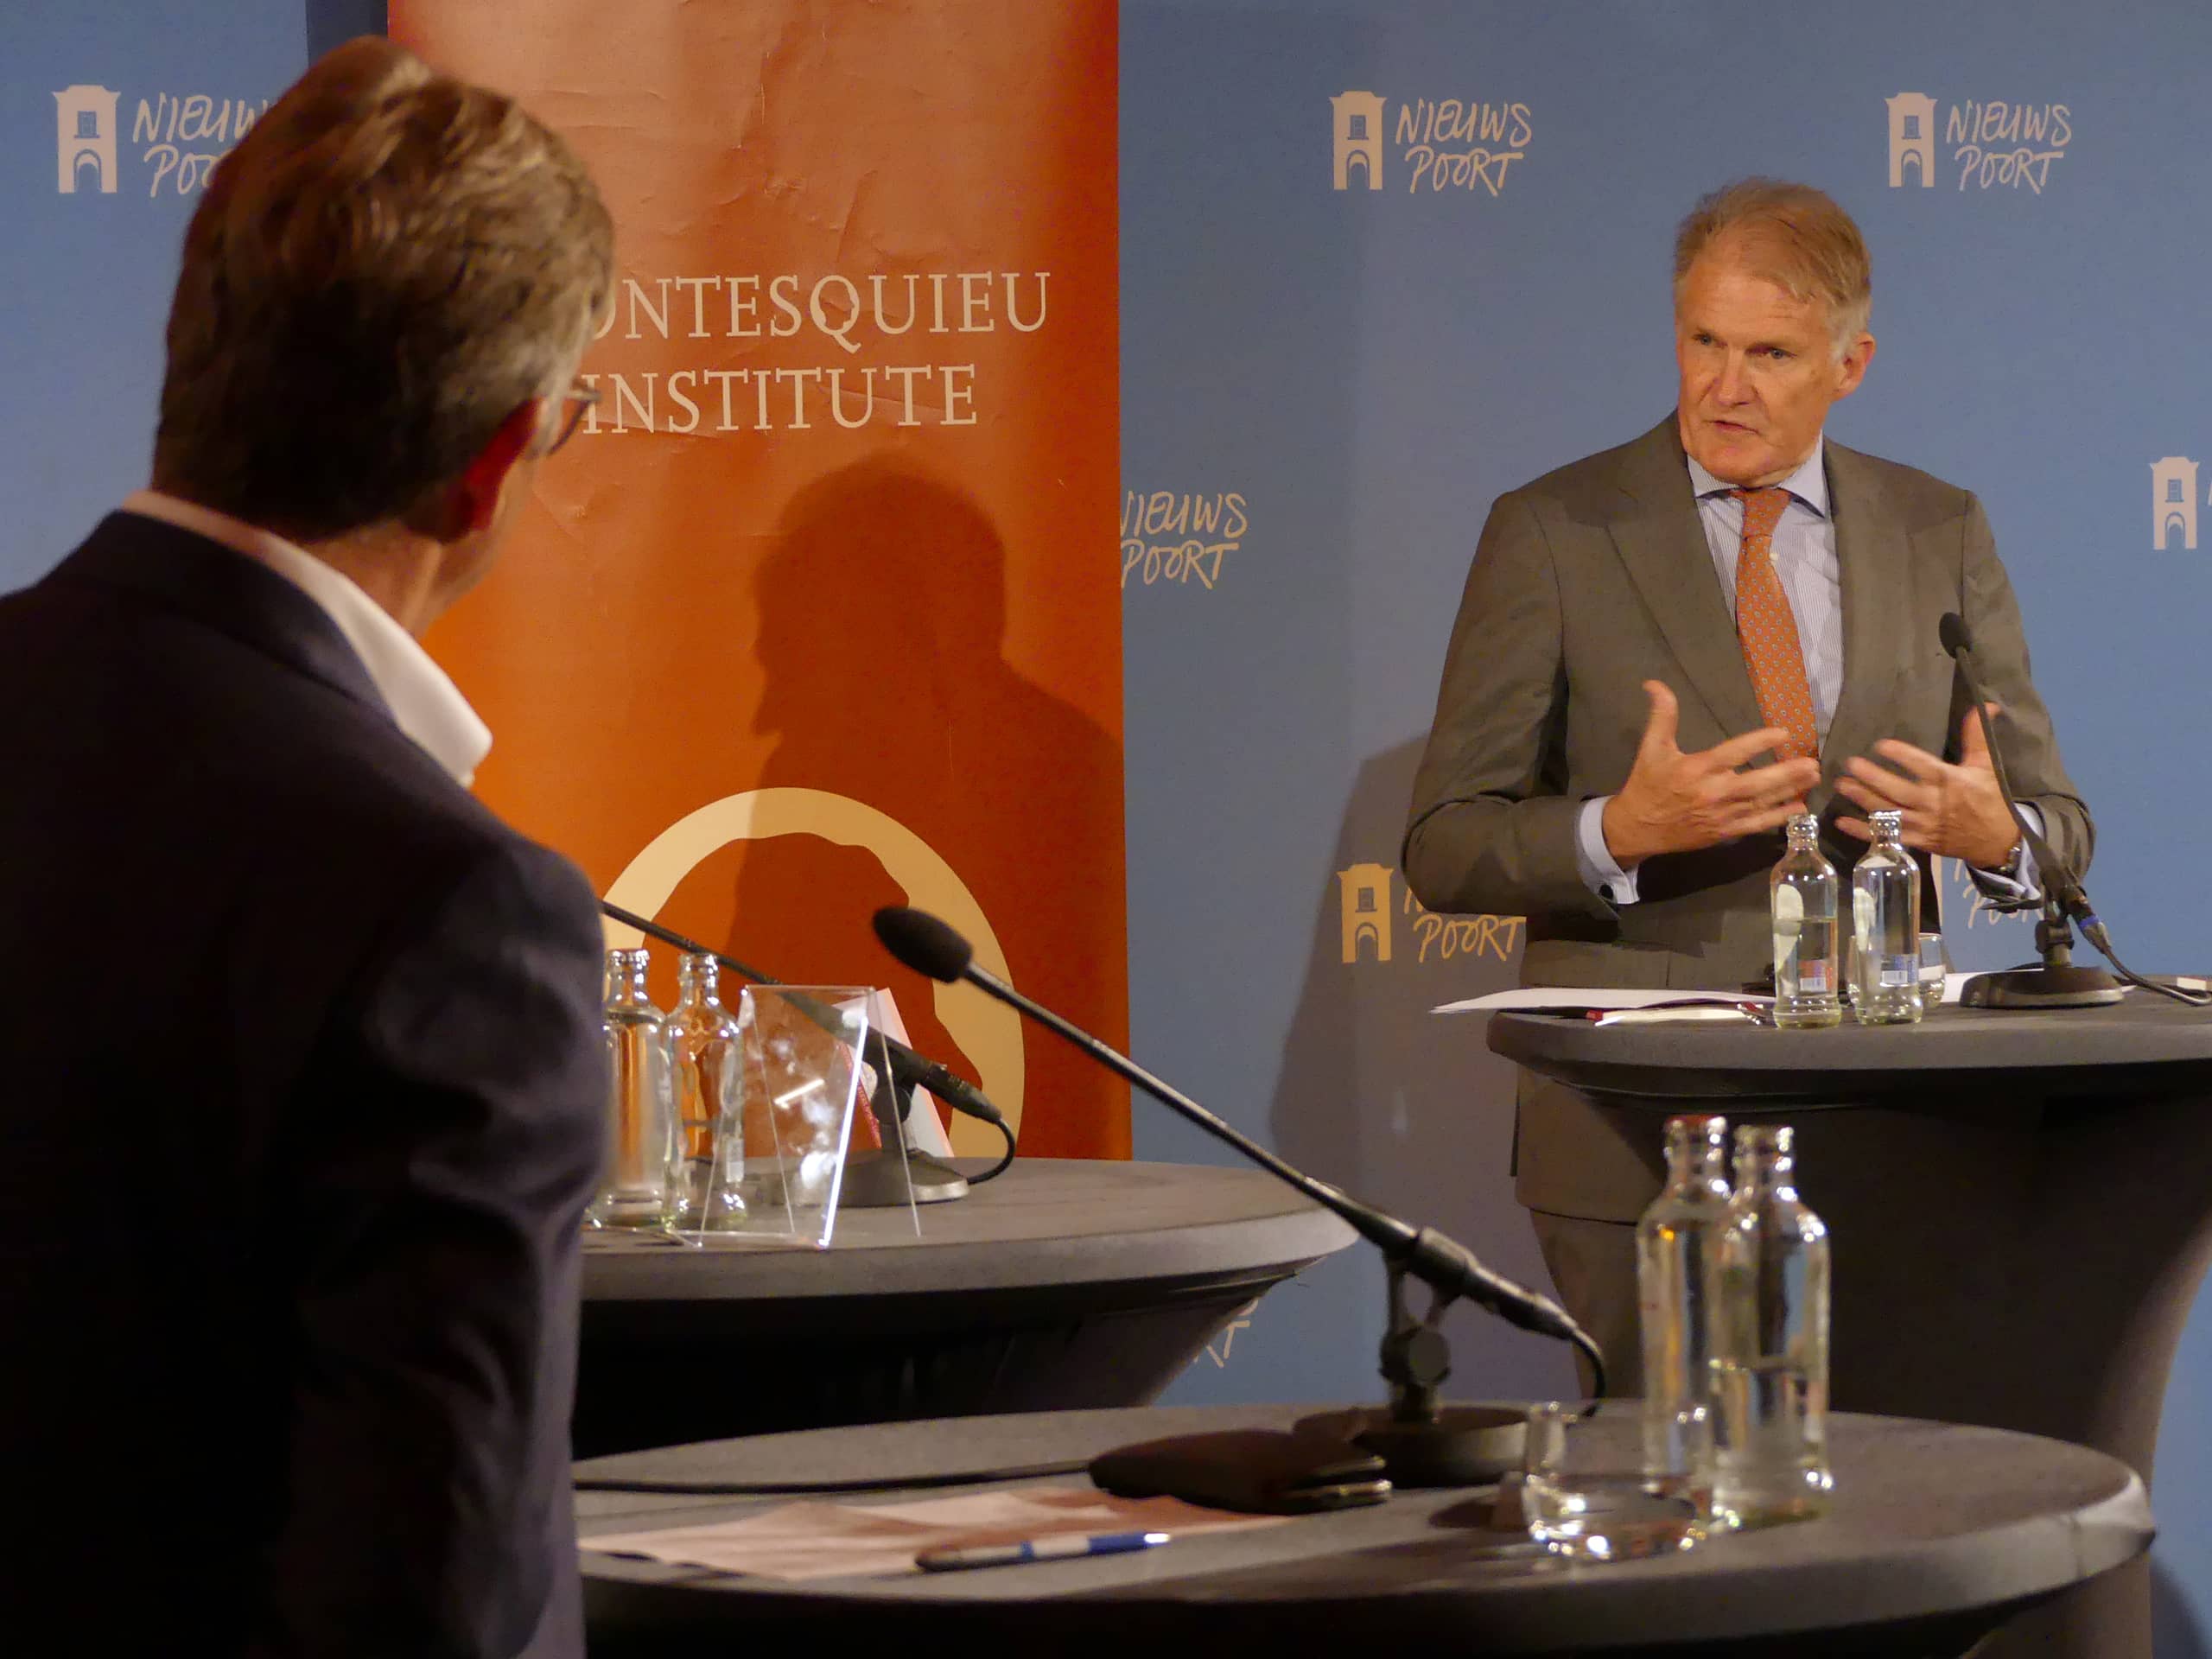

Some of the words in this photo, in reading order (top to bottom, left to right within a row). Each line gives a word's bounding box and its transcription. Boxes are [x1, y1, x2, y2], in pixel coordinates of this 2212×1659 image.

[1395, 96, 1532, 148] NIEUWS
[1946, 99, 2071, 147] NIEUWS
[1404, 144, 1524, 198] POORT
[1955, 144, 2064, 194] POORT
[582, 364, 977, 434] INSTITUTE
[1121, 538, 1240, 590] POORT
[1413, 913, 1527, 963] POORT
